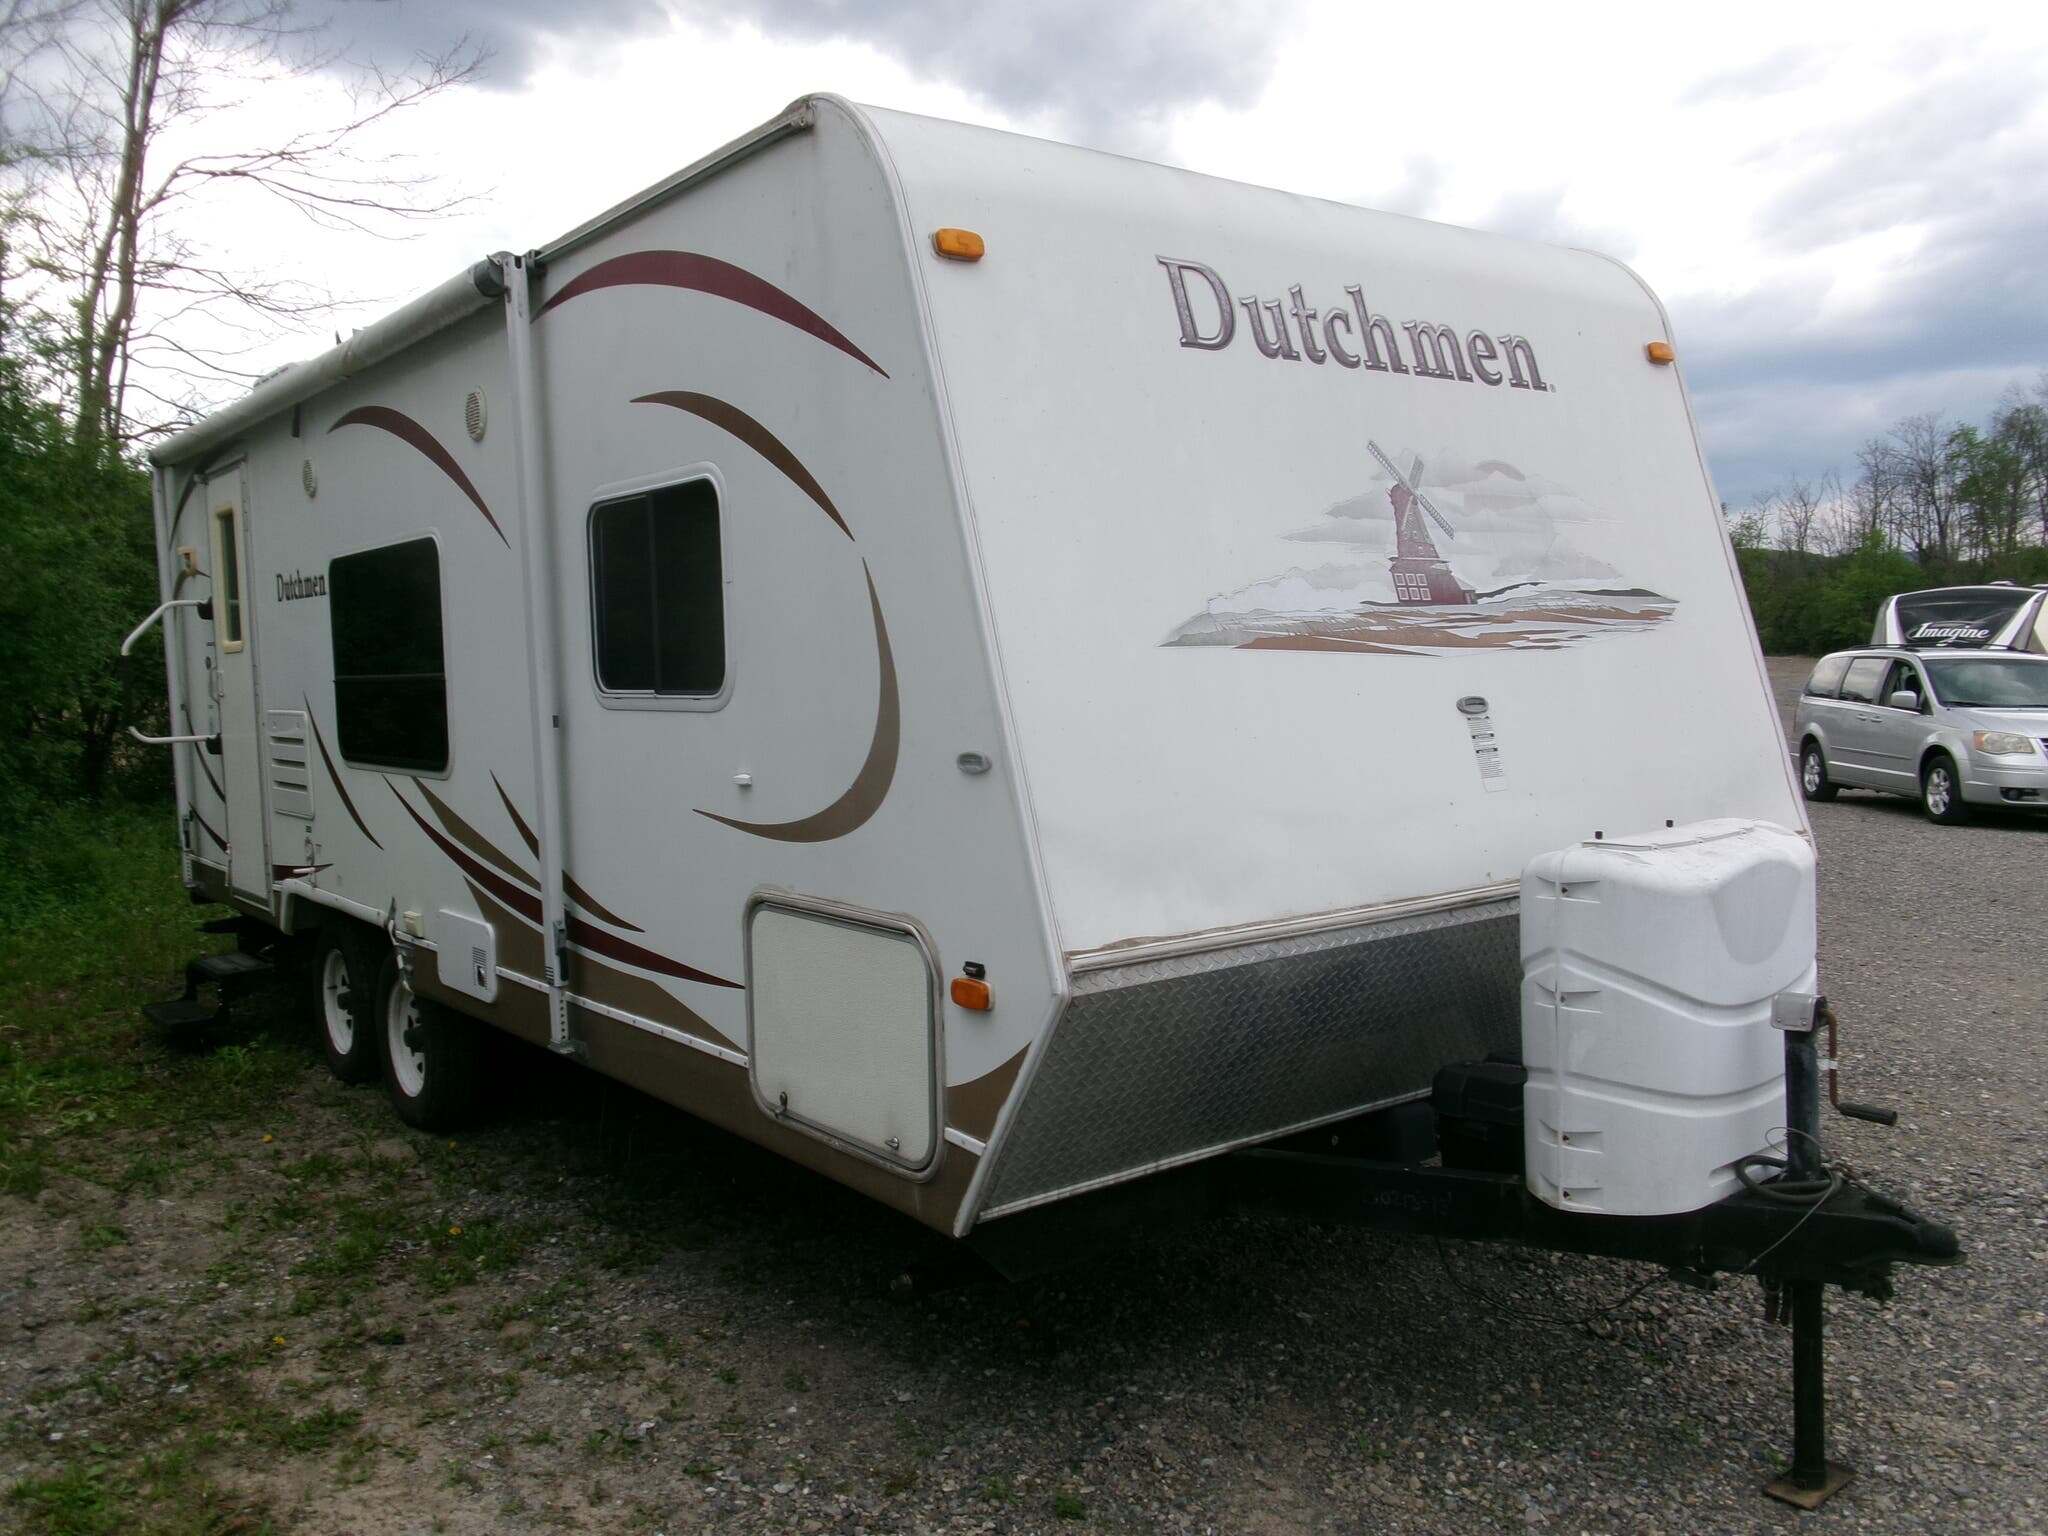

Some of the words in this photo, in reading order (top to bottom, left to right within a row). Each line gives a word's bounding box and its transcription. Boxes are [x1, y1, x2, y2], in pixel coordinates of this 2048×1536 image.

[1155, 254, 1549, 392] Dutchmen
[276, 570, 326, 602] Dutchmen
[1914, 622, 1990, 641] Imagine
